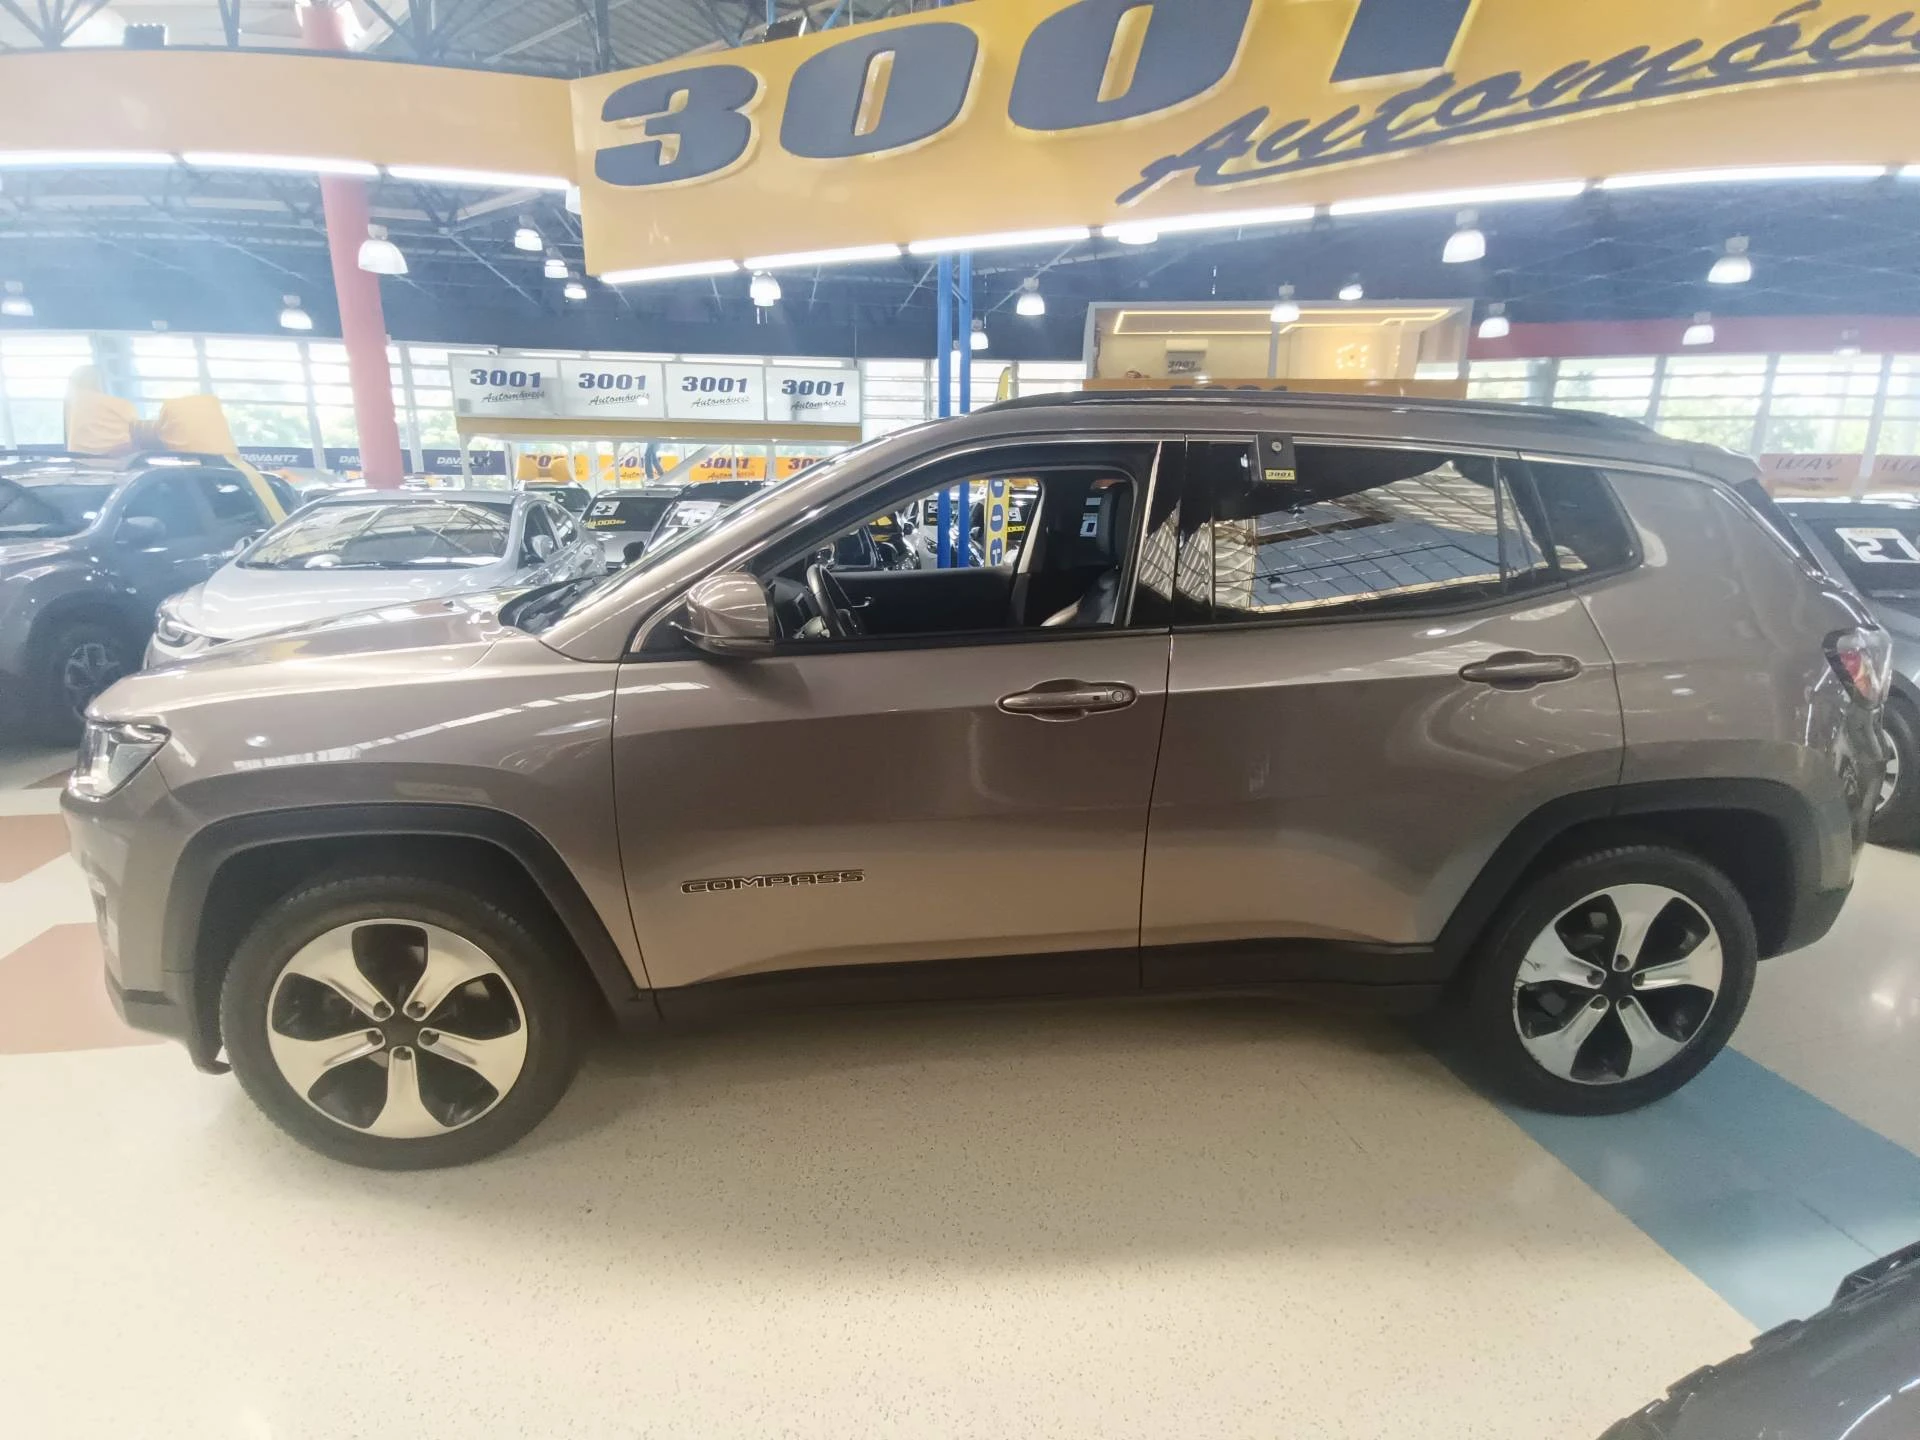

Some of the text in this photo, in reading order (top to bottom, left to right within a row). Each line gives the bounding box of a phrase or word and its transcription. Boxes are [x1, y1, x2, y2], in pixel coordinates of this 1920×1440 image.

[470, 369, 541, 388] 3001
[578, 373, 646, 390] 3001
[682, 376, 748, 393] 3001
[781, 380, 845, 396] 3001
[680, 868, 865, 894] COMPASS
